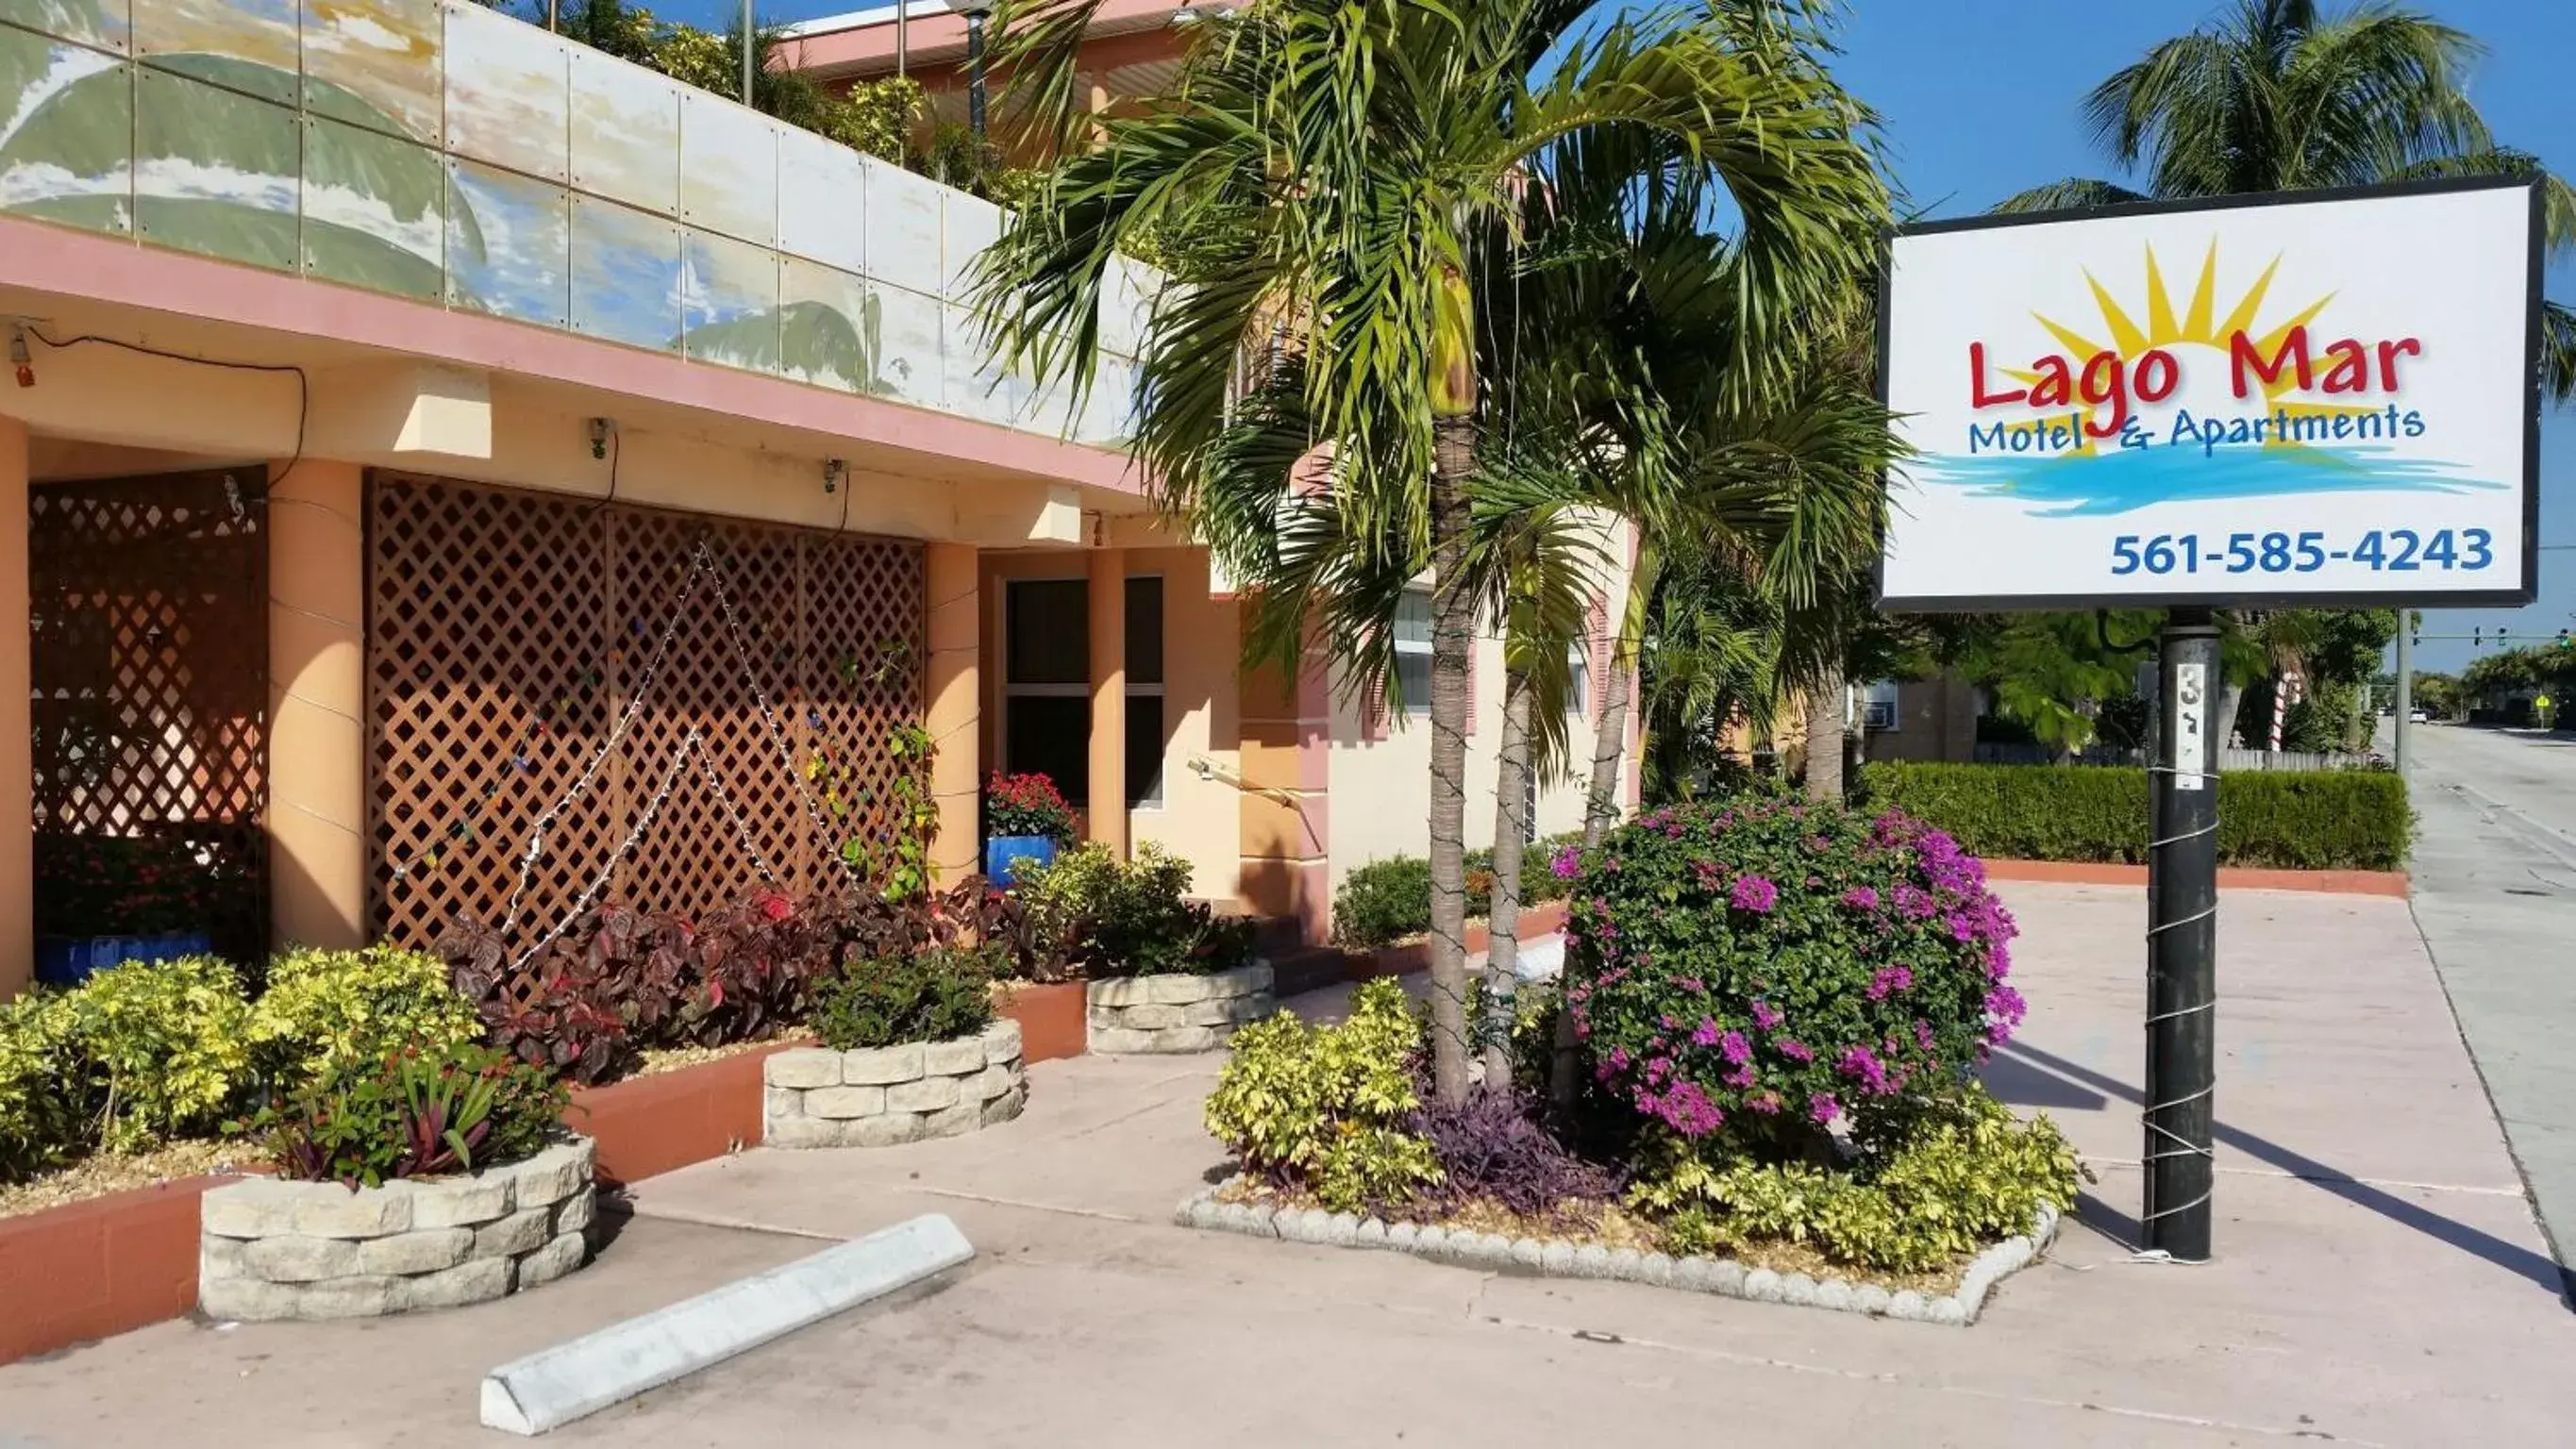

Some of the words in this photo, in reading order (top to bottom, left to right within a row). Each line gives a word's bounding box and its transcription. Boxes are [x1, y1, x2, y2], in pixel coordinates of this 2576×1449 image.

[1969, 341, 2179, 439] Lago
[2230, 325, 2421, 399] Mar
[1969, 412, 2082, 453] Motel
[2120, 415, 2155, 450] &
[2170, 404, 2425, 458] Apartments
[2111, 527, 2493, 575] 561-585-4243
